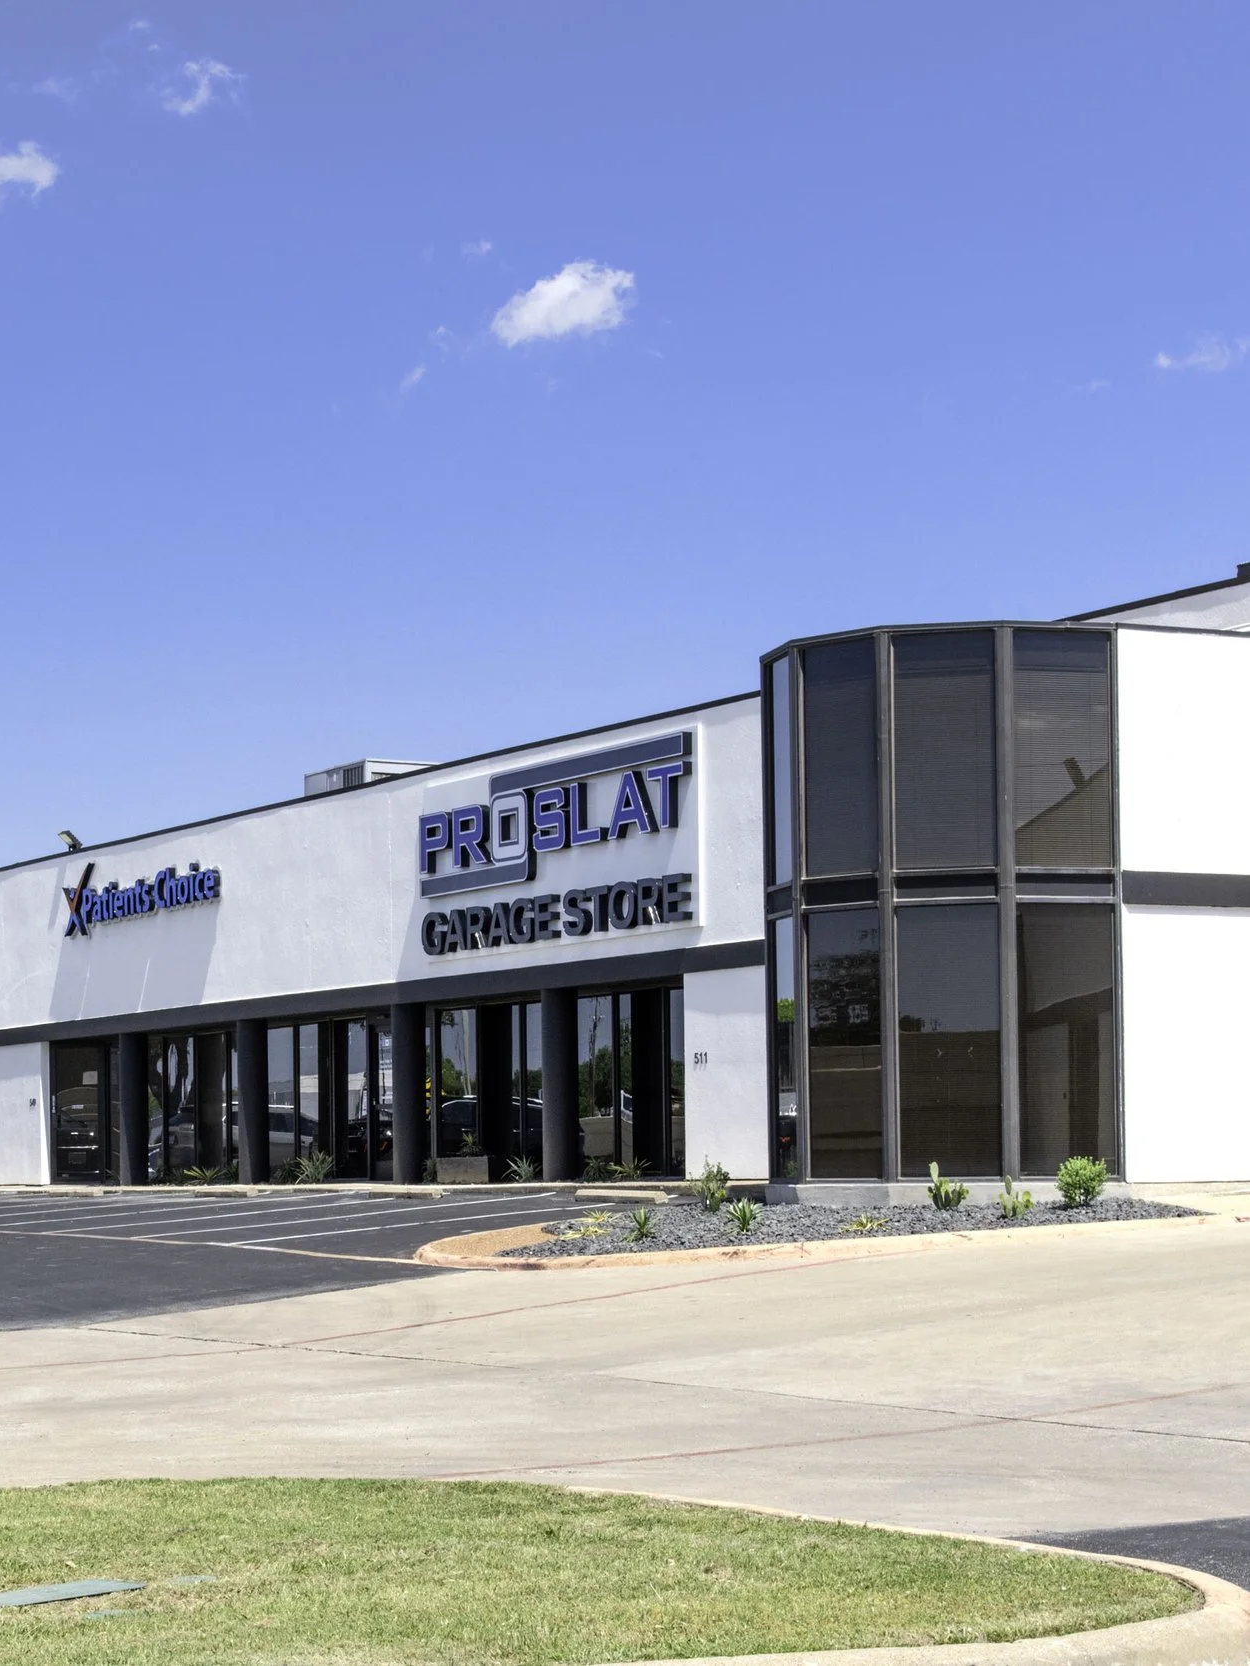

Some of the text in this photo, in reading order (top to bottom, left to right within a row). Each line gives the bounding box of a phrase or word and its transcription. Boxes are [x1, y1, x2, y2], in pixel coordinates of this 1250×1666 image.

[419, 760, 692, 874] PROSLAT
[81, 862, 220, 924] Patients Choice
[421, 872, 693, 956] GARAGE STORE
[694, 1051, 708, 1065] 511
